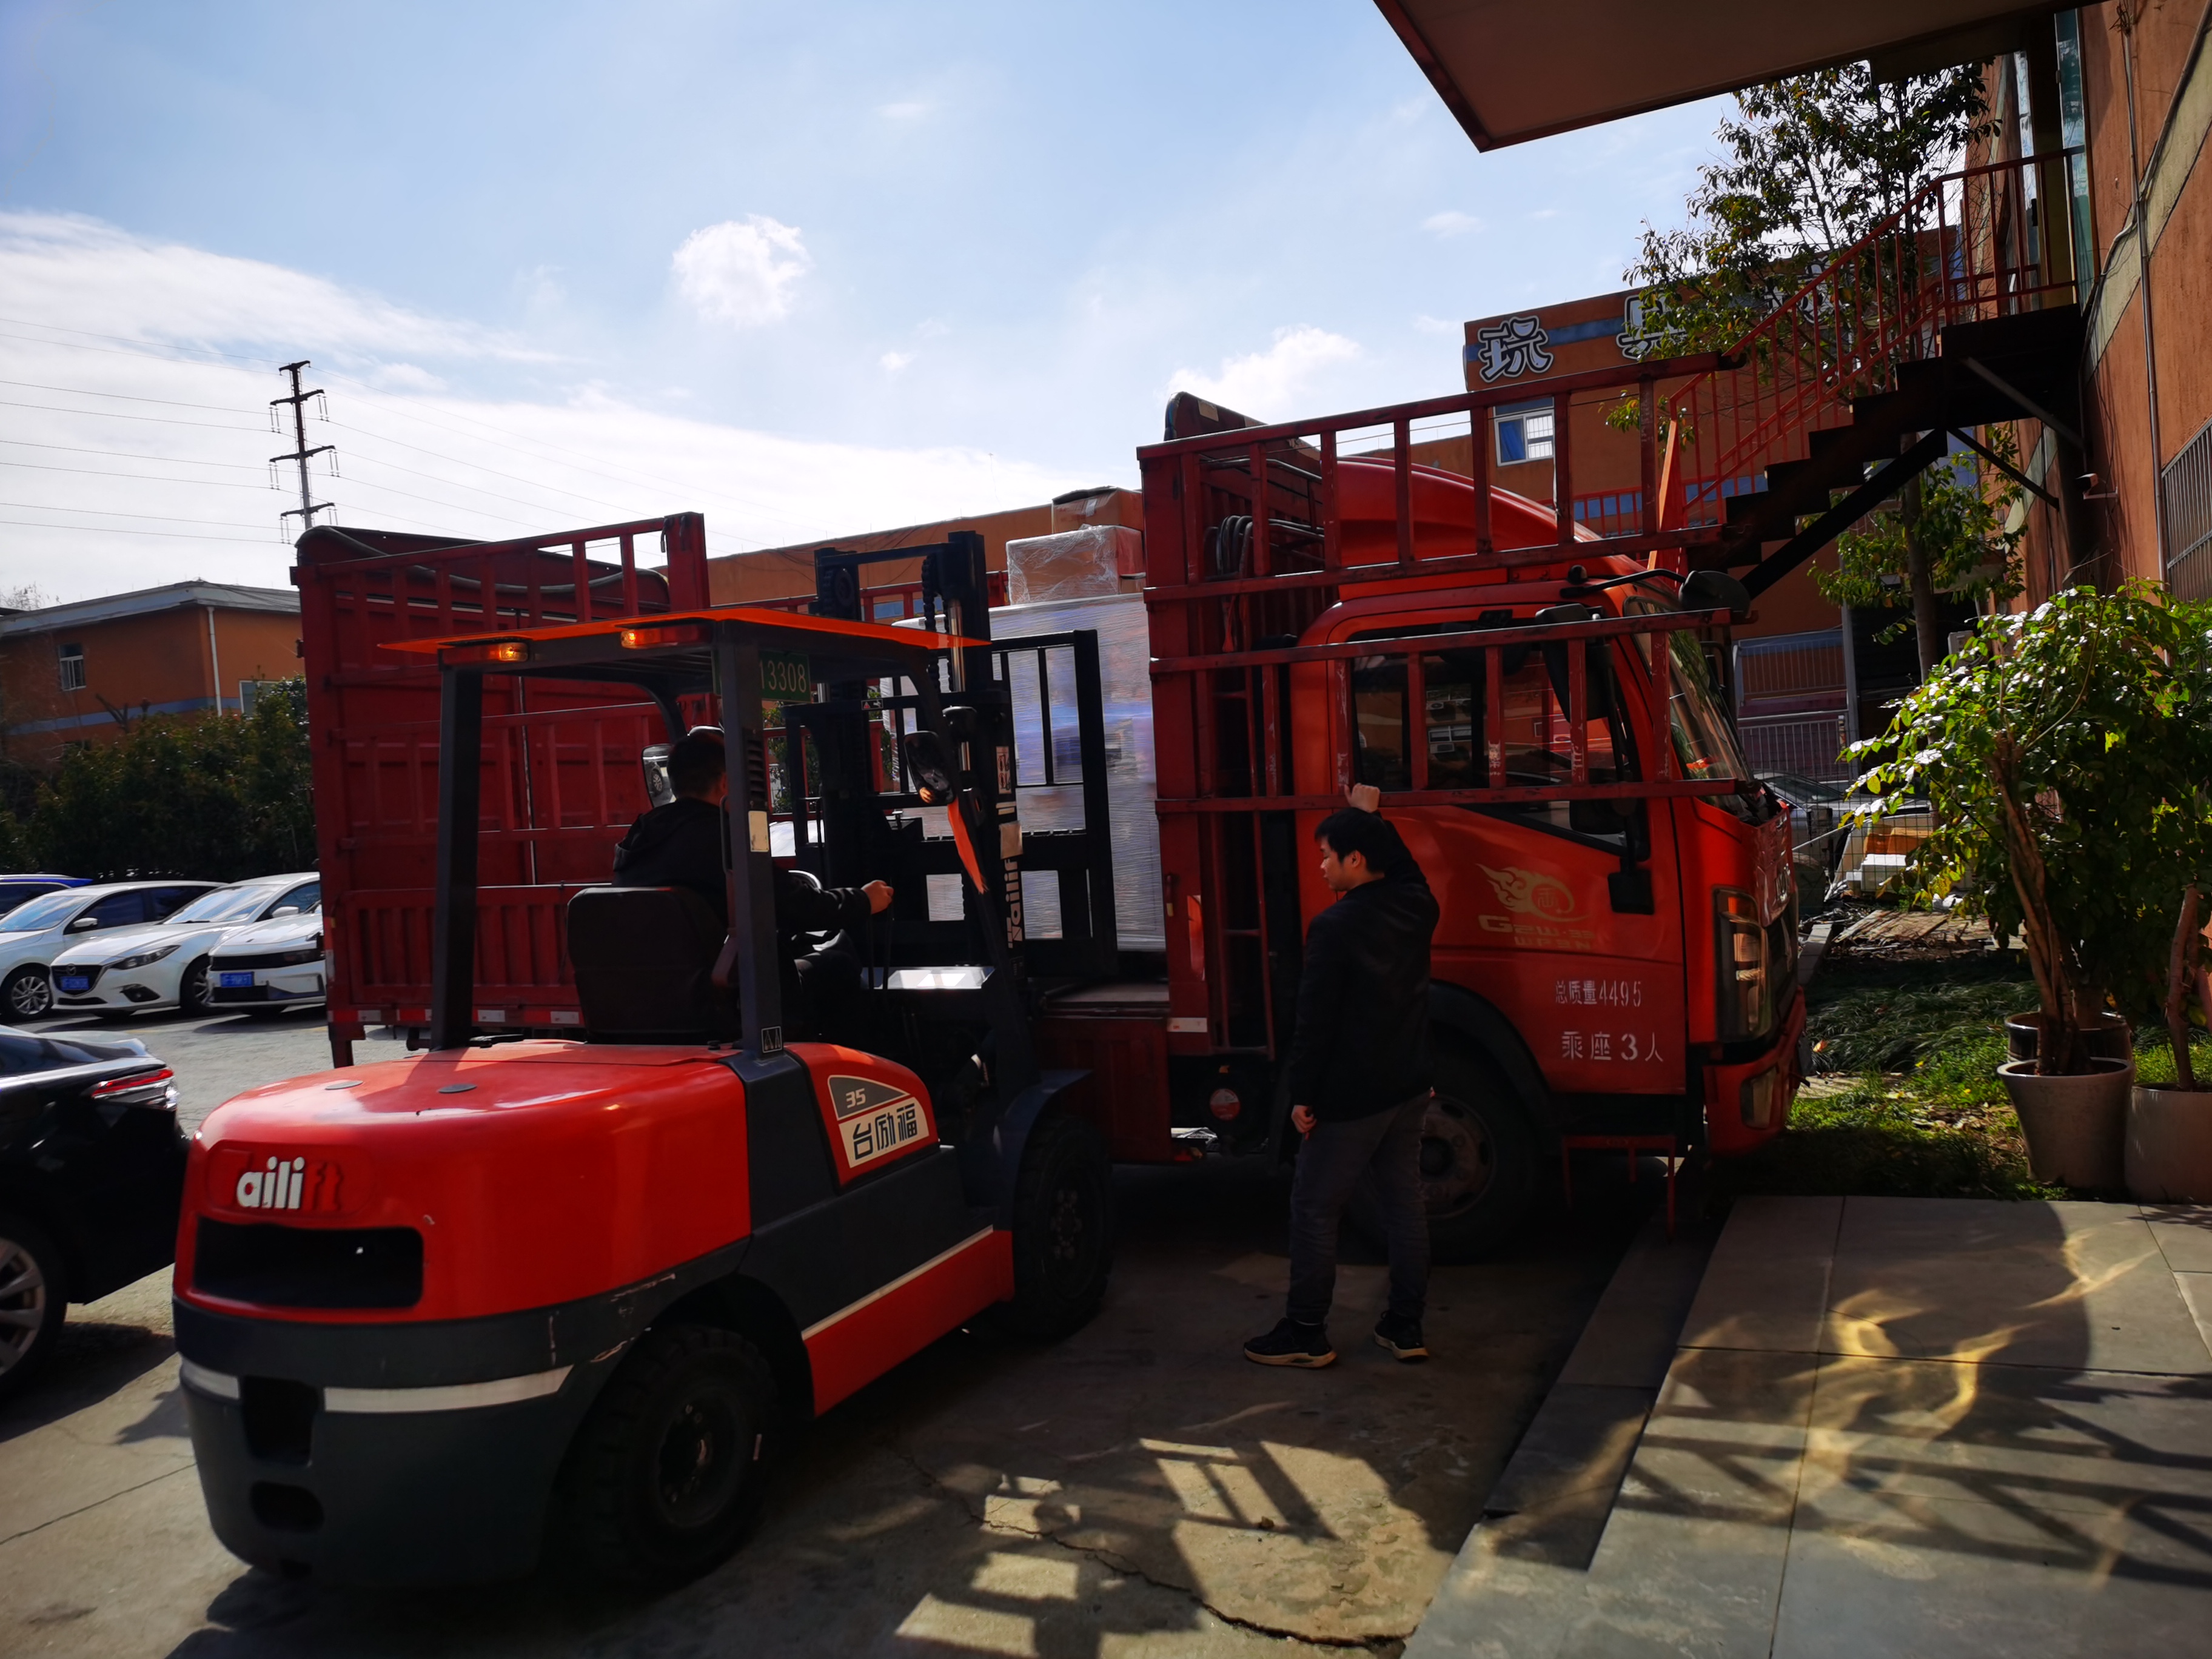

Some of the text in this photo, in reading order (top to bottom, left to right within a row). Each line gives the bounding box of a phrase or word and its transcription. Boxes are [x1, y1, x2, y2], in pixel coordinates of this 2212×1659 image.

[845, 1088, 866, 1108] 35
[853, 1103, 917, 1160] 台励福
